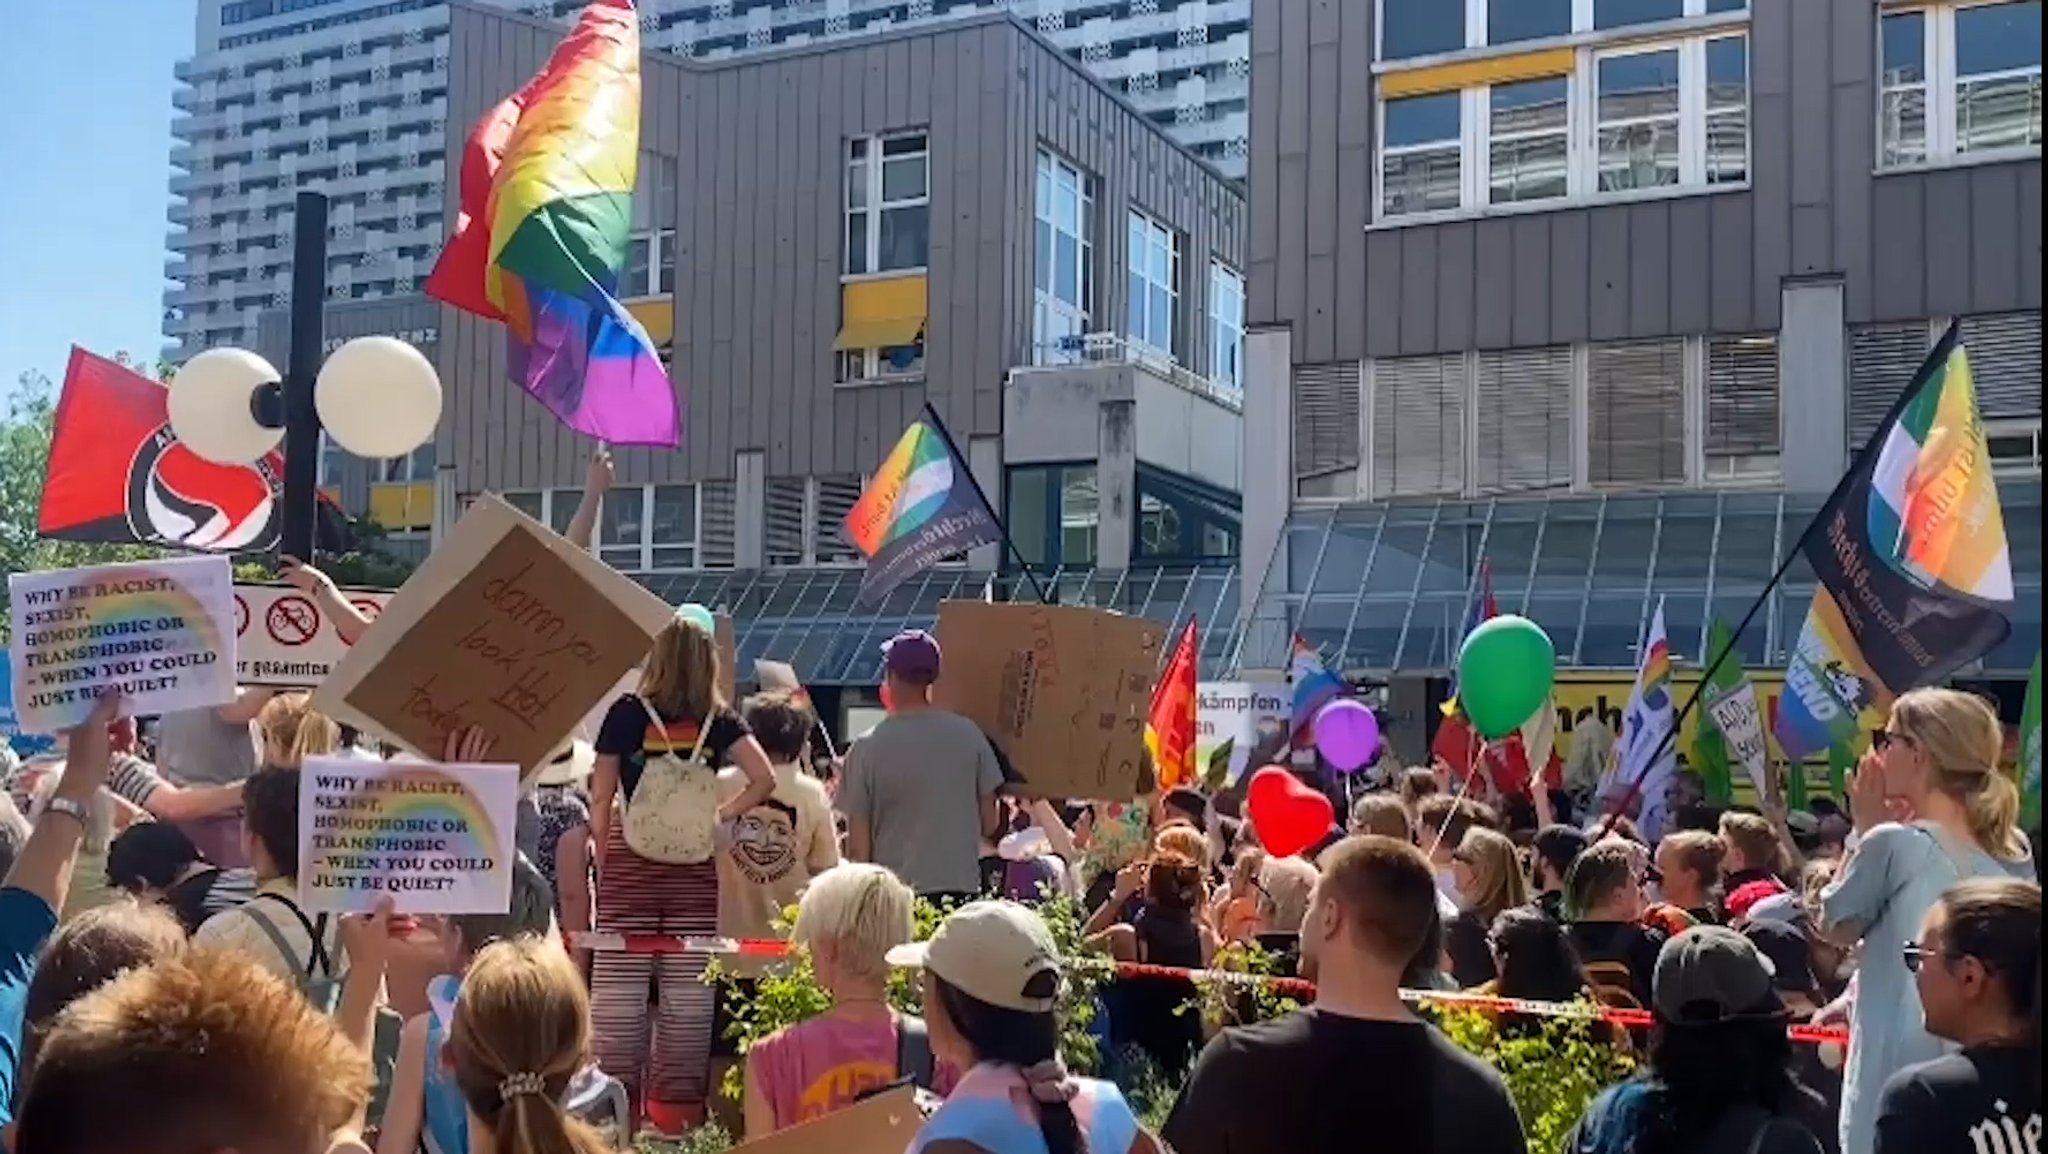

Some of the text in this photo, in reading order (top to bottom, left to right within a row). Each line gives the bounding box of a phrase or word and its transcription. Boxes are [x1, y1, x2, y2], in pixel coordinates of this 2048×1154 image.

[25, 577, 176, 606] WHY BE RACIST,
[25, 606, 91, 626] SEXIST,
[483, 561, 603, 667] damn you
[25, 616, 184, 647] HOMOPHOBIC OR
[26, 638, 164, 668] TRANSPHOBIC
[40, 667, 96, 685] WHEN
[99, 660, 144, 677] YOU
[150, 650, 217, 671] COULD
[456, 619, 568, 722] look Hot
[28, 690, 75, 709] JUST
[79, 684, 102, 700] BE
[316, 776, 465, 796] WHY BE RACIST,
[314, 796, 383, 813] SEXIST,
[314, 815, 468, 833] HOMOPHOBIC OR
[312, 835, 446, 851] TRANSPHOBIC
[326, 856, 380, 870] WHEN
[386, 858, 425, 871] YOU
[430, 858, 494, 871] COULD
[312, 875, 457, 893] JUST BE QUIET?
